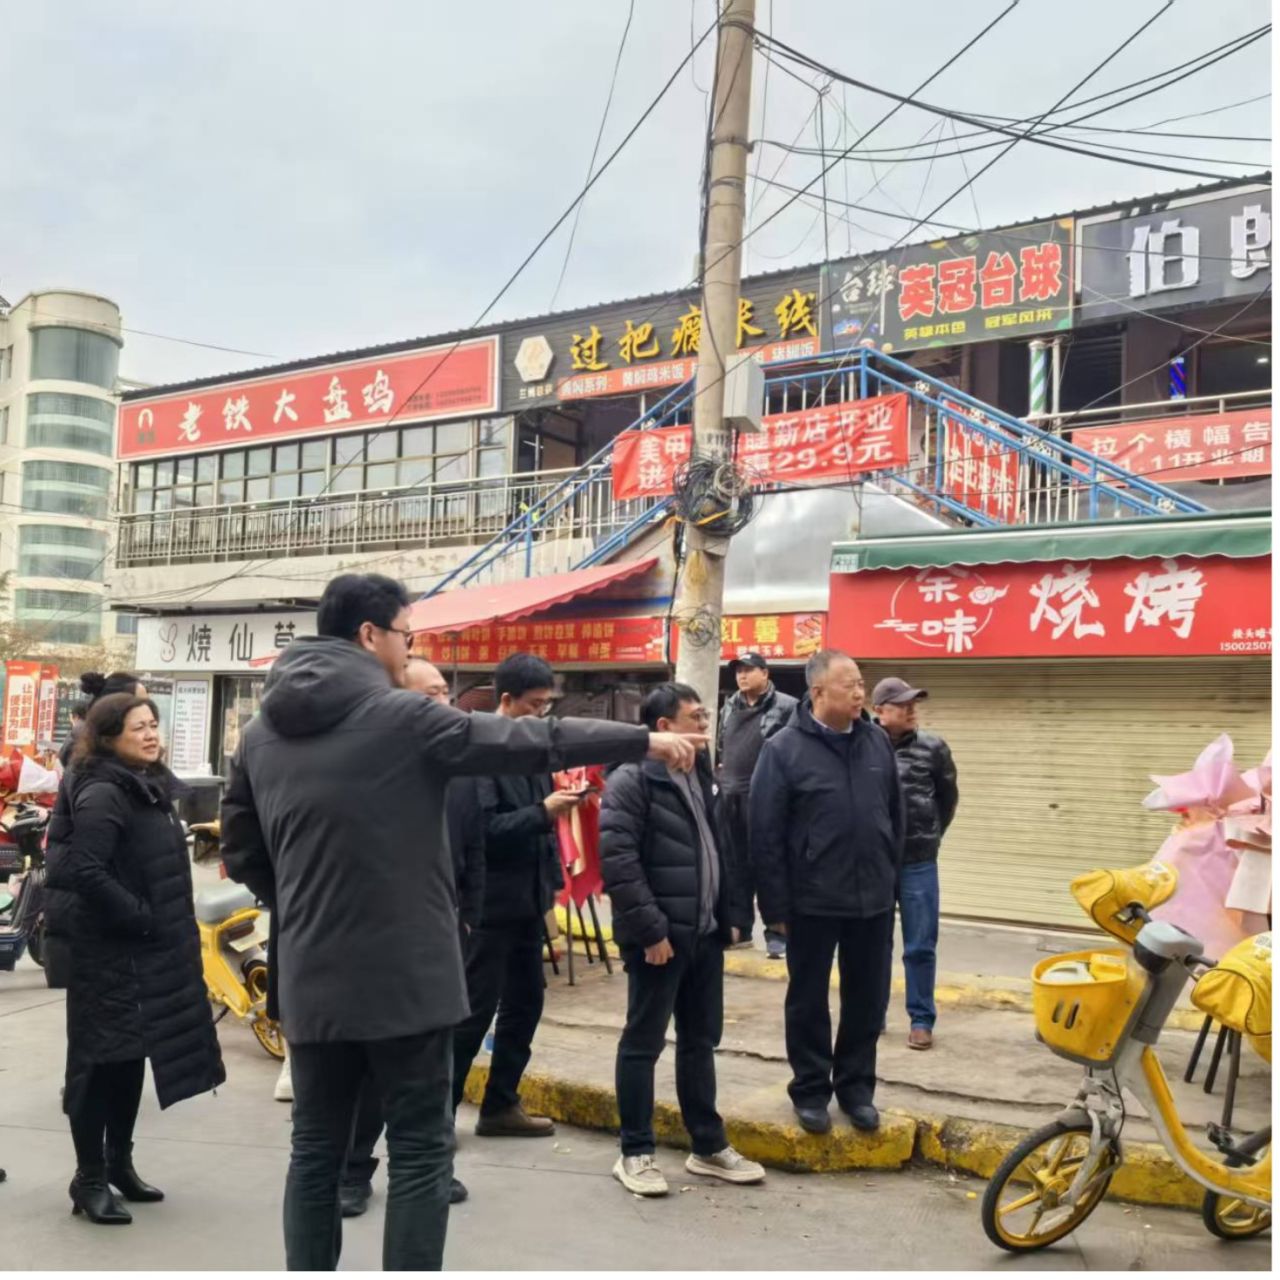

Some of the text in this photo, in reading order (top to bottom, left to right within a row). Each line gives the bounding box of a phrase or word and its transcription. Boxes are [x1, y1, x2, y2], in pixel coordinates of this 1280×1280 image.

[898, 242, 1062, 322] 英冠台球
[176, 369, 395, 442] 老铁大盘鸡
[1090, 420, 1271, 458] 拉个横幅告
[1028, 560, 1207, 640] 烧烤
